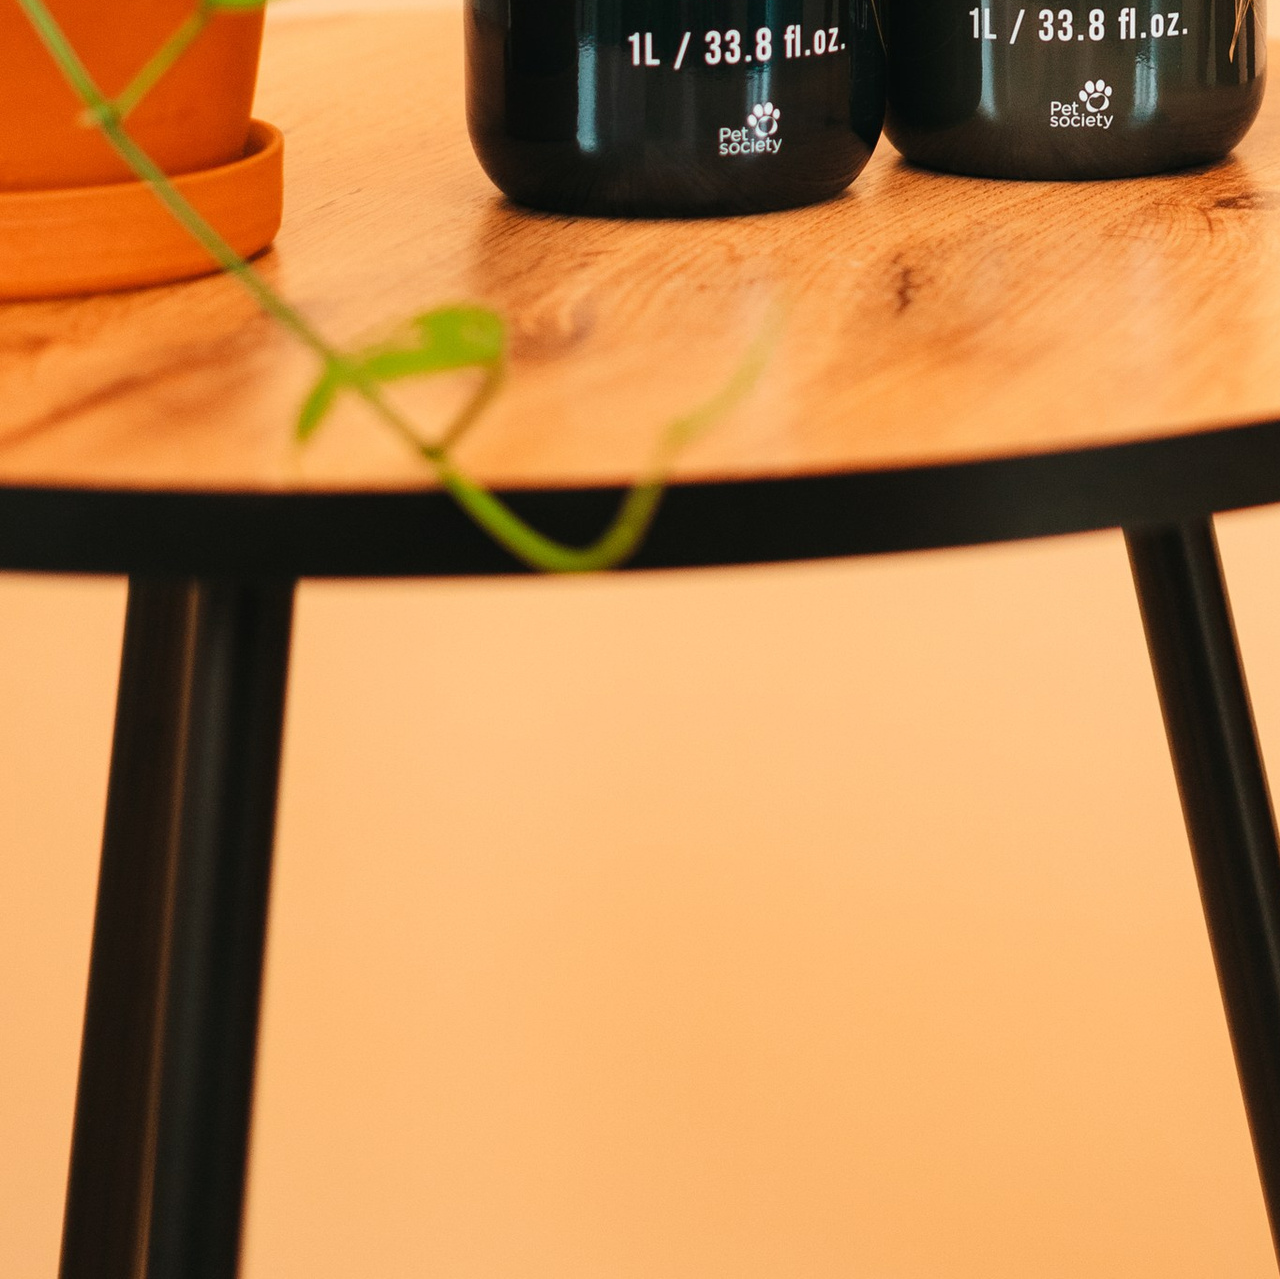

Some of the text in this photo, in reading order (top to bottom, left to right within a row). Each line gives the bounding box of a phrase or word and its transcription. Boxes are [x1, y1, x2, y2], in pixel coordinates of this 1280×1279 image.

[969, 7, 1189, 45] 1L / 33.8 fl.oz.
[628, 24, 847, 70] 1L / 33.8 fl.oz.
[1050, 101, 1080, 116] Pet
[1050, 112, 1114, 129] society
[719, 127, 749, 143] Pet
[719, 136, 783, 155] society
